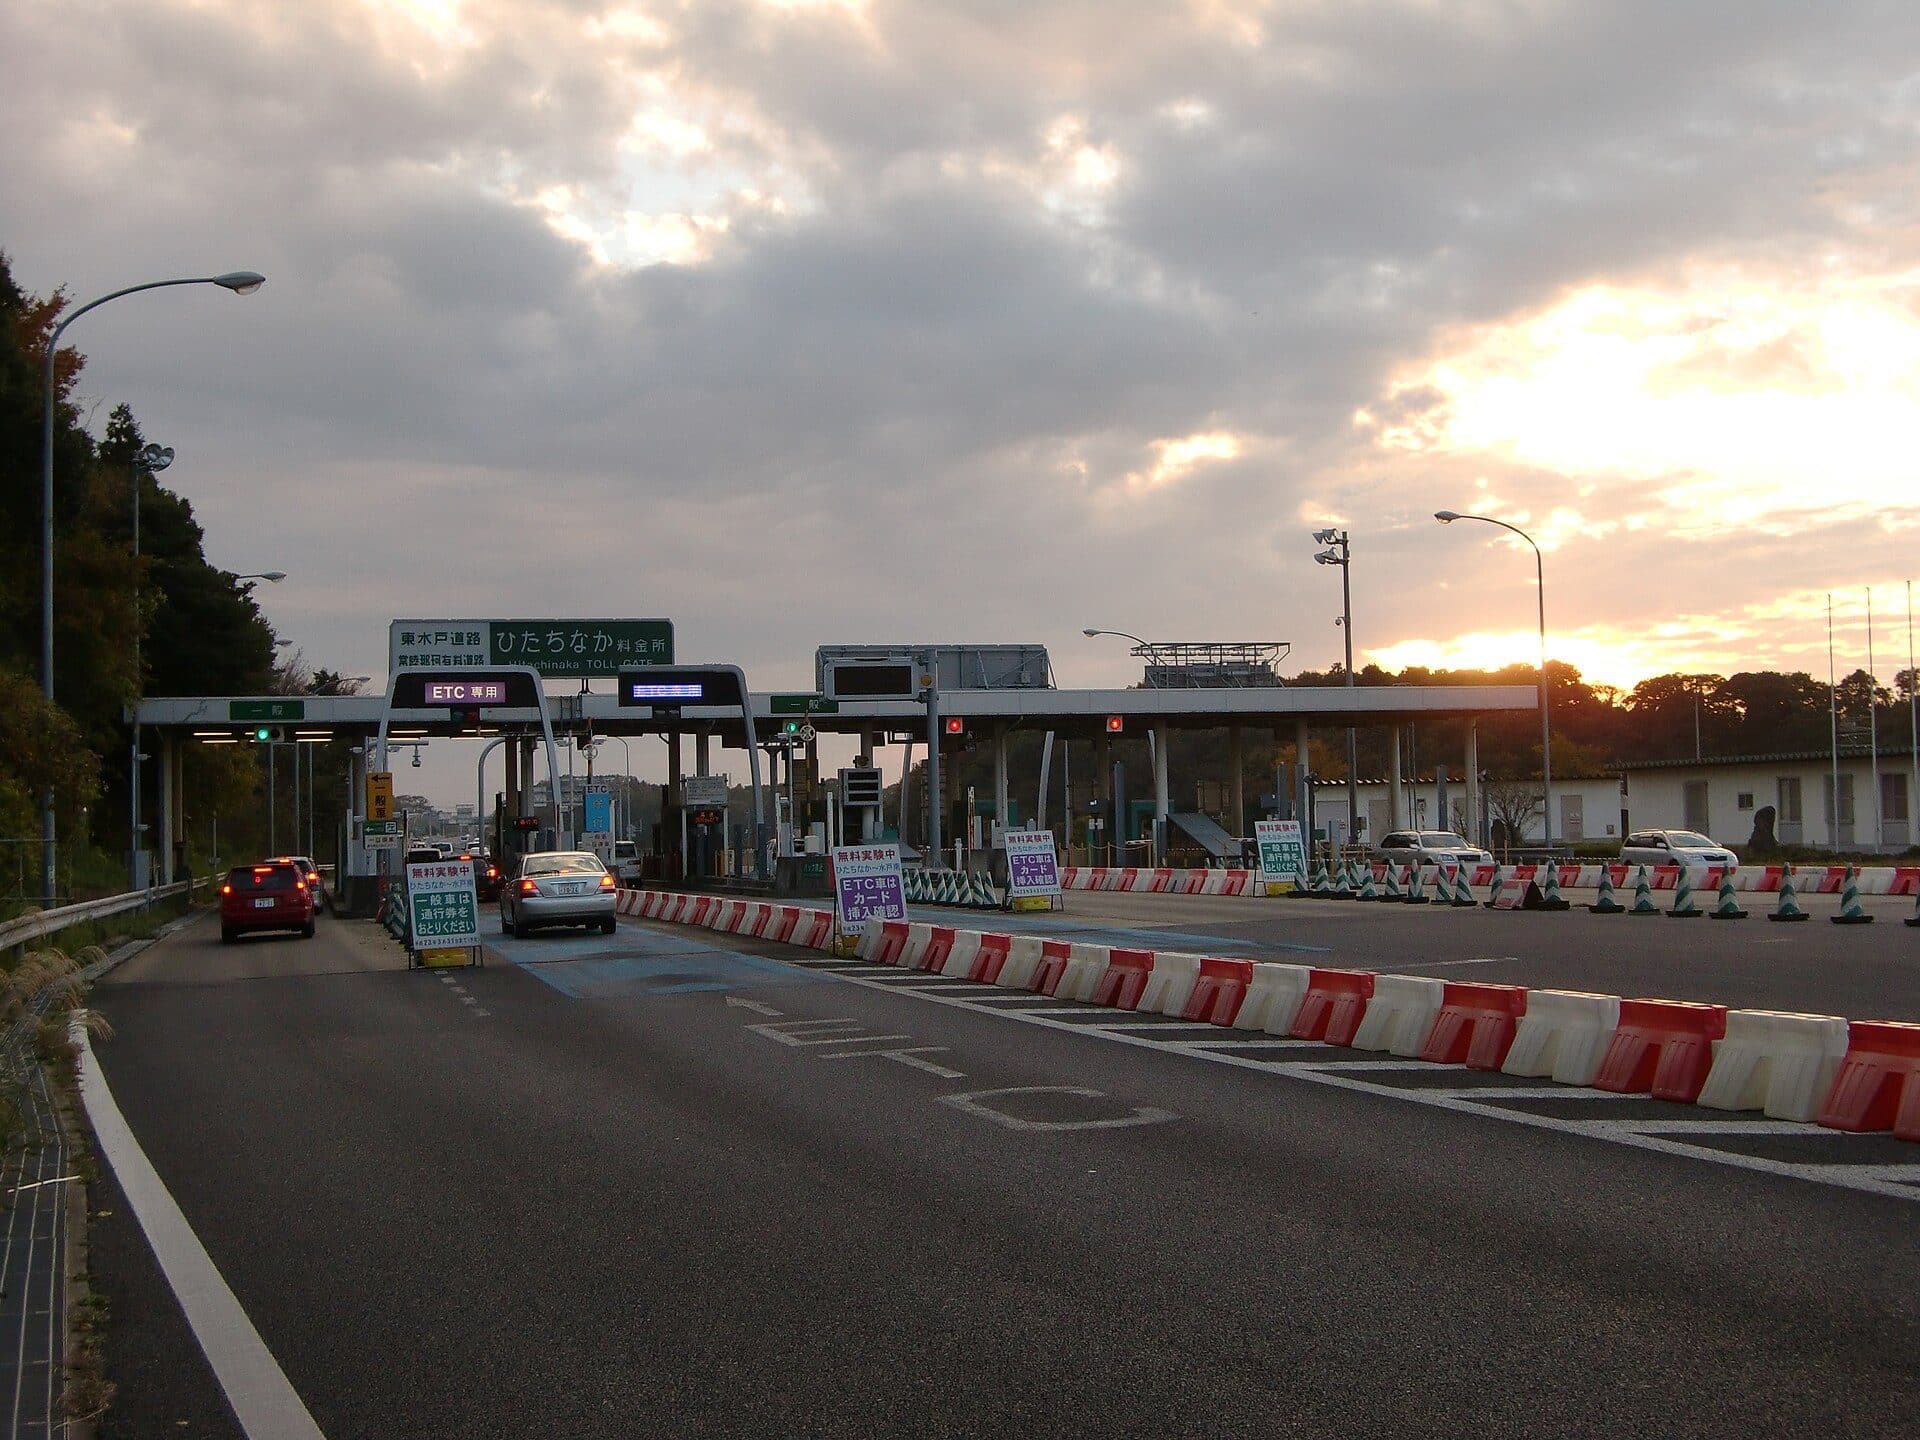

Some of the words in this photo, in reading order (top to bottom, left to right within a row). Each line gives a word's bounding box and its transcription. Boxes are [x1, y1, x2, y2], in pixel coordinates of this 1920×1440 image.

[401, 631, 481, 646] 東水戸道路
[586, 659, 616, 669] TOLL
[587, 785, 607, 793] ETC
[1008, 834, 1050, 844] 無料実験中
[837, 849, 895, 862] 無料実験中
[1012, 854, 1052, 865] ETC車は
[412, 866, 470, 879] 無料実験中
[1020, 864, 1048, 875] カード
[843, 877, 897, 891] ETC車は
[416, 893, 471, 906] 一般車は
[854, 891, 891, 905] カード
[421, 907, 469, 920] 通行券を
[417, 921, 474, 935] おとりください
[743, 1017, 1180, 1131] ETC
